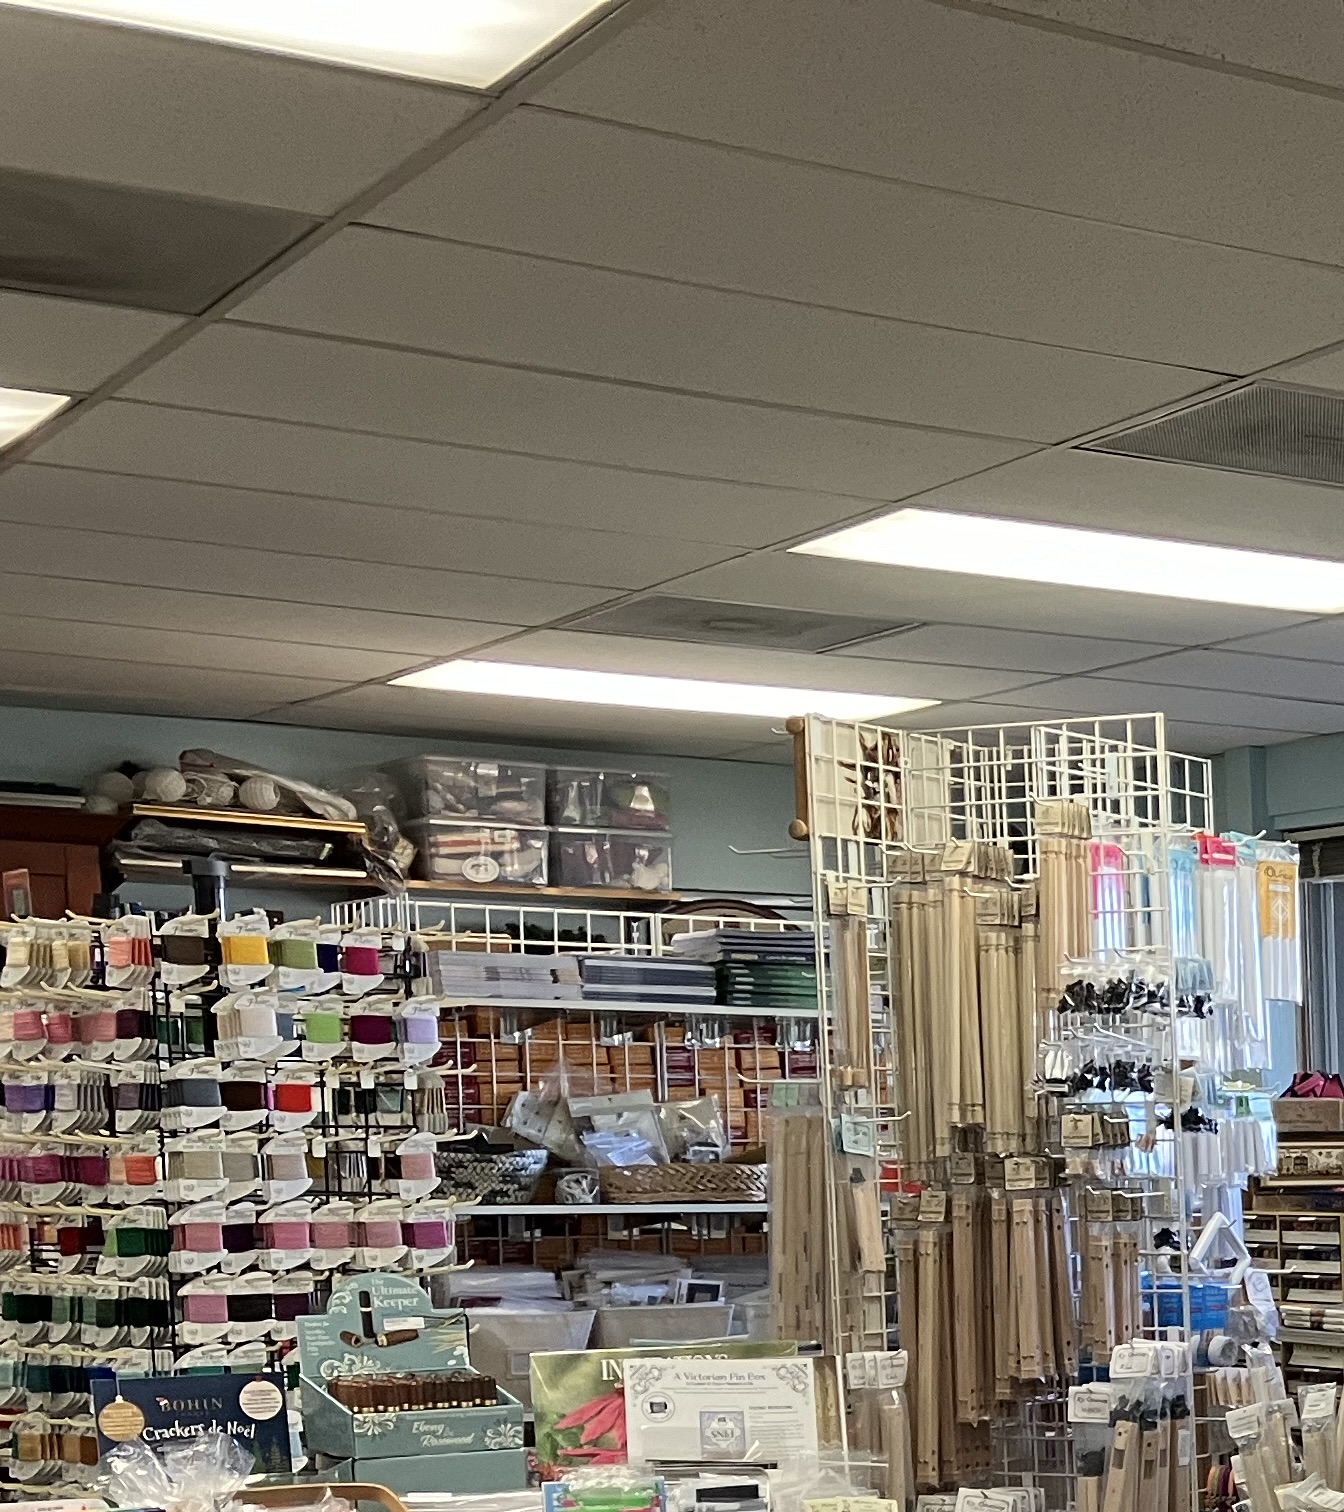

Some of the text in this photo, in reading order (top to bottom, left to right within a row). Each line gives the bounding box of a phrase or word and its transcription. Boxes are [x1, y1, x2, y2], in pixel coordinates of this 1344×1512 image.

[372, 1285, 417, 1296] Ultimate
[372, 1296, 419, 1311] Keeper
[142, 1420, 205, 1442] Crackers
[209, 1419, 223, 1434] de
[227, 1421, 256, 1439] Noël
